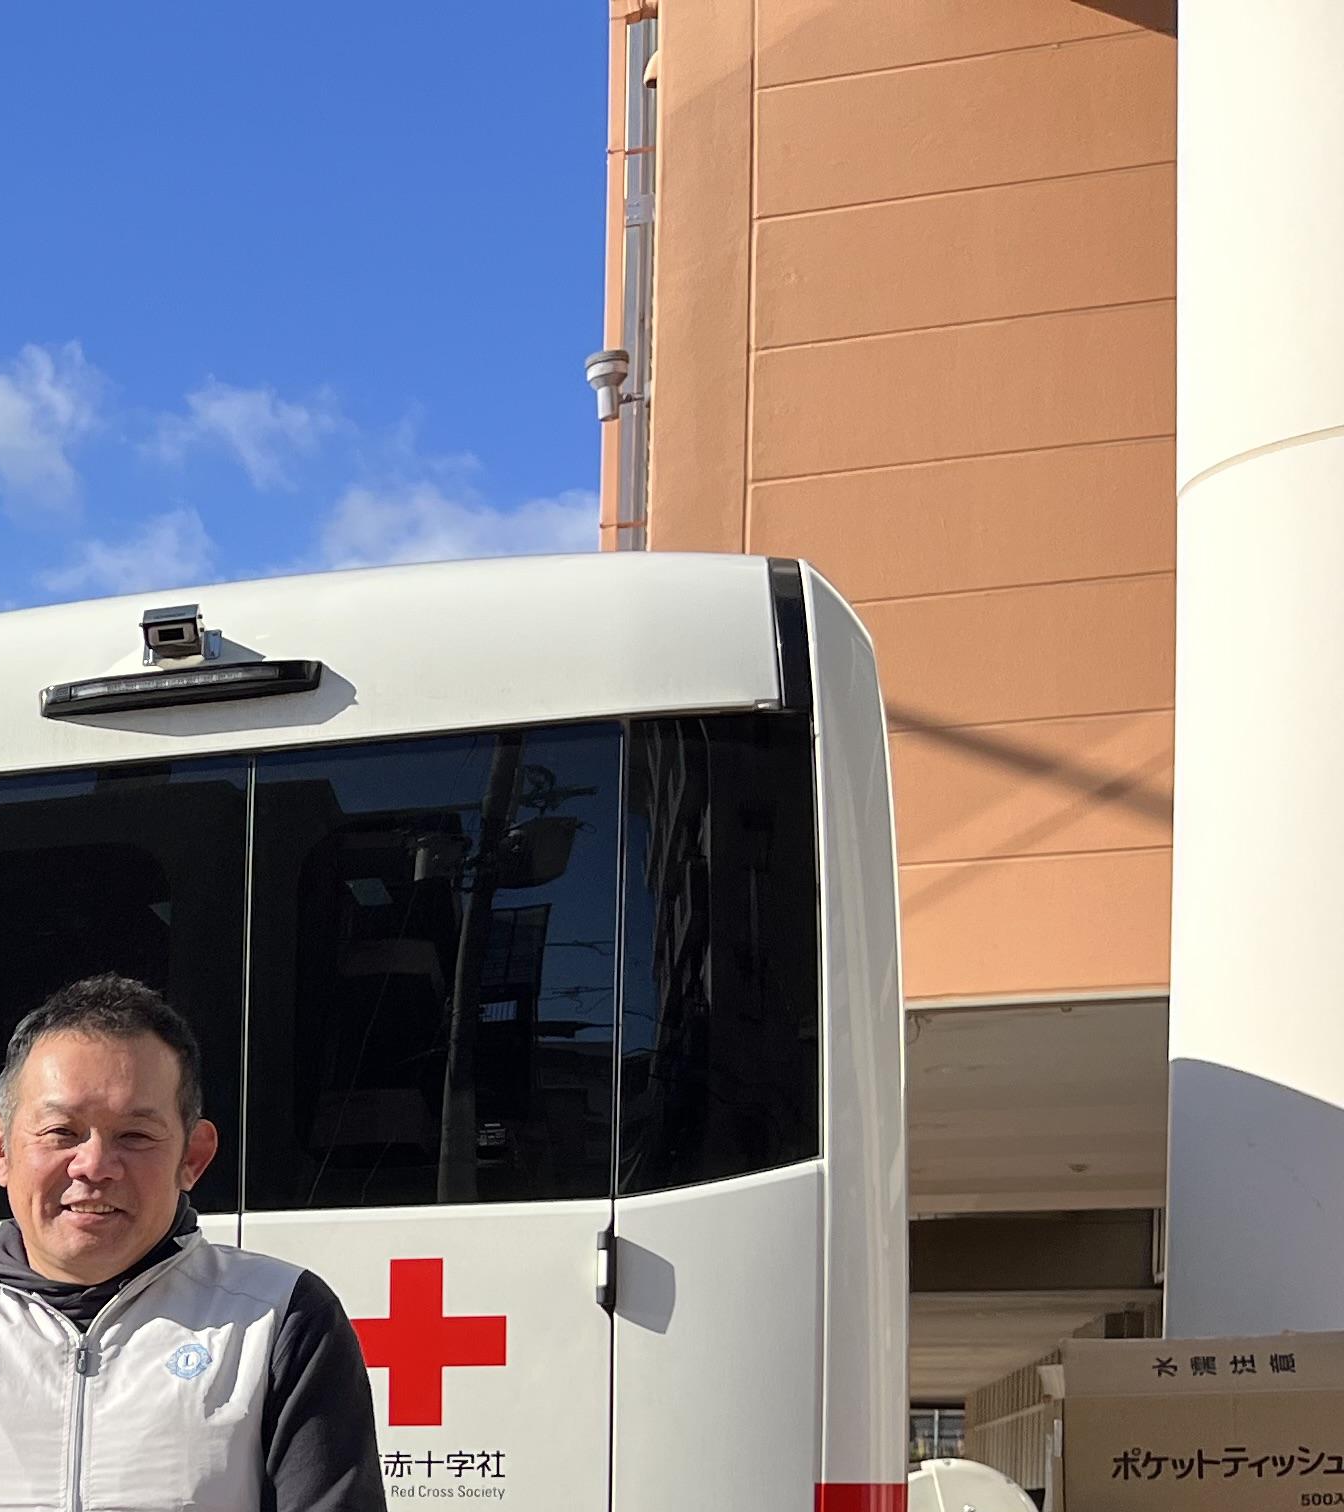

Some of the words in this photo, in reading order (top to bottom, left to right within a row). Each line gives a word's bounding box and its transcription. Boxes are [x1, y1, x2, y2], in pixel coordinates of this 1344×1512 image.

[379, 1450, 506, 1478] 赤十字社
[1112, 1446, 1344, 1481] ポケットティッシュ
[390, 1485, 415, 1498] Red
[418, 1485, 454, 1498] Cross
[457, 1485, 506, 1500] Society
